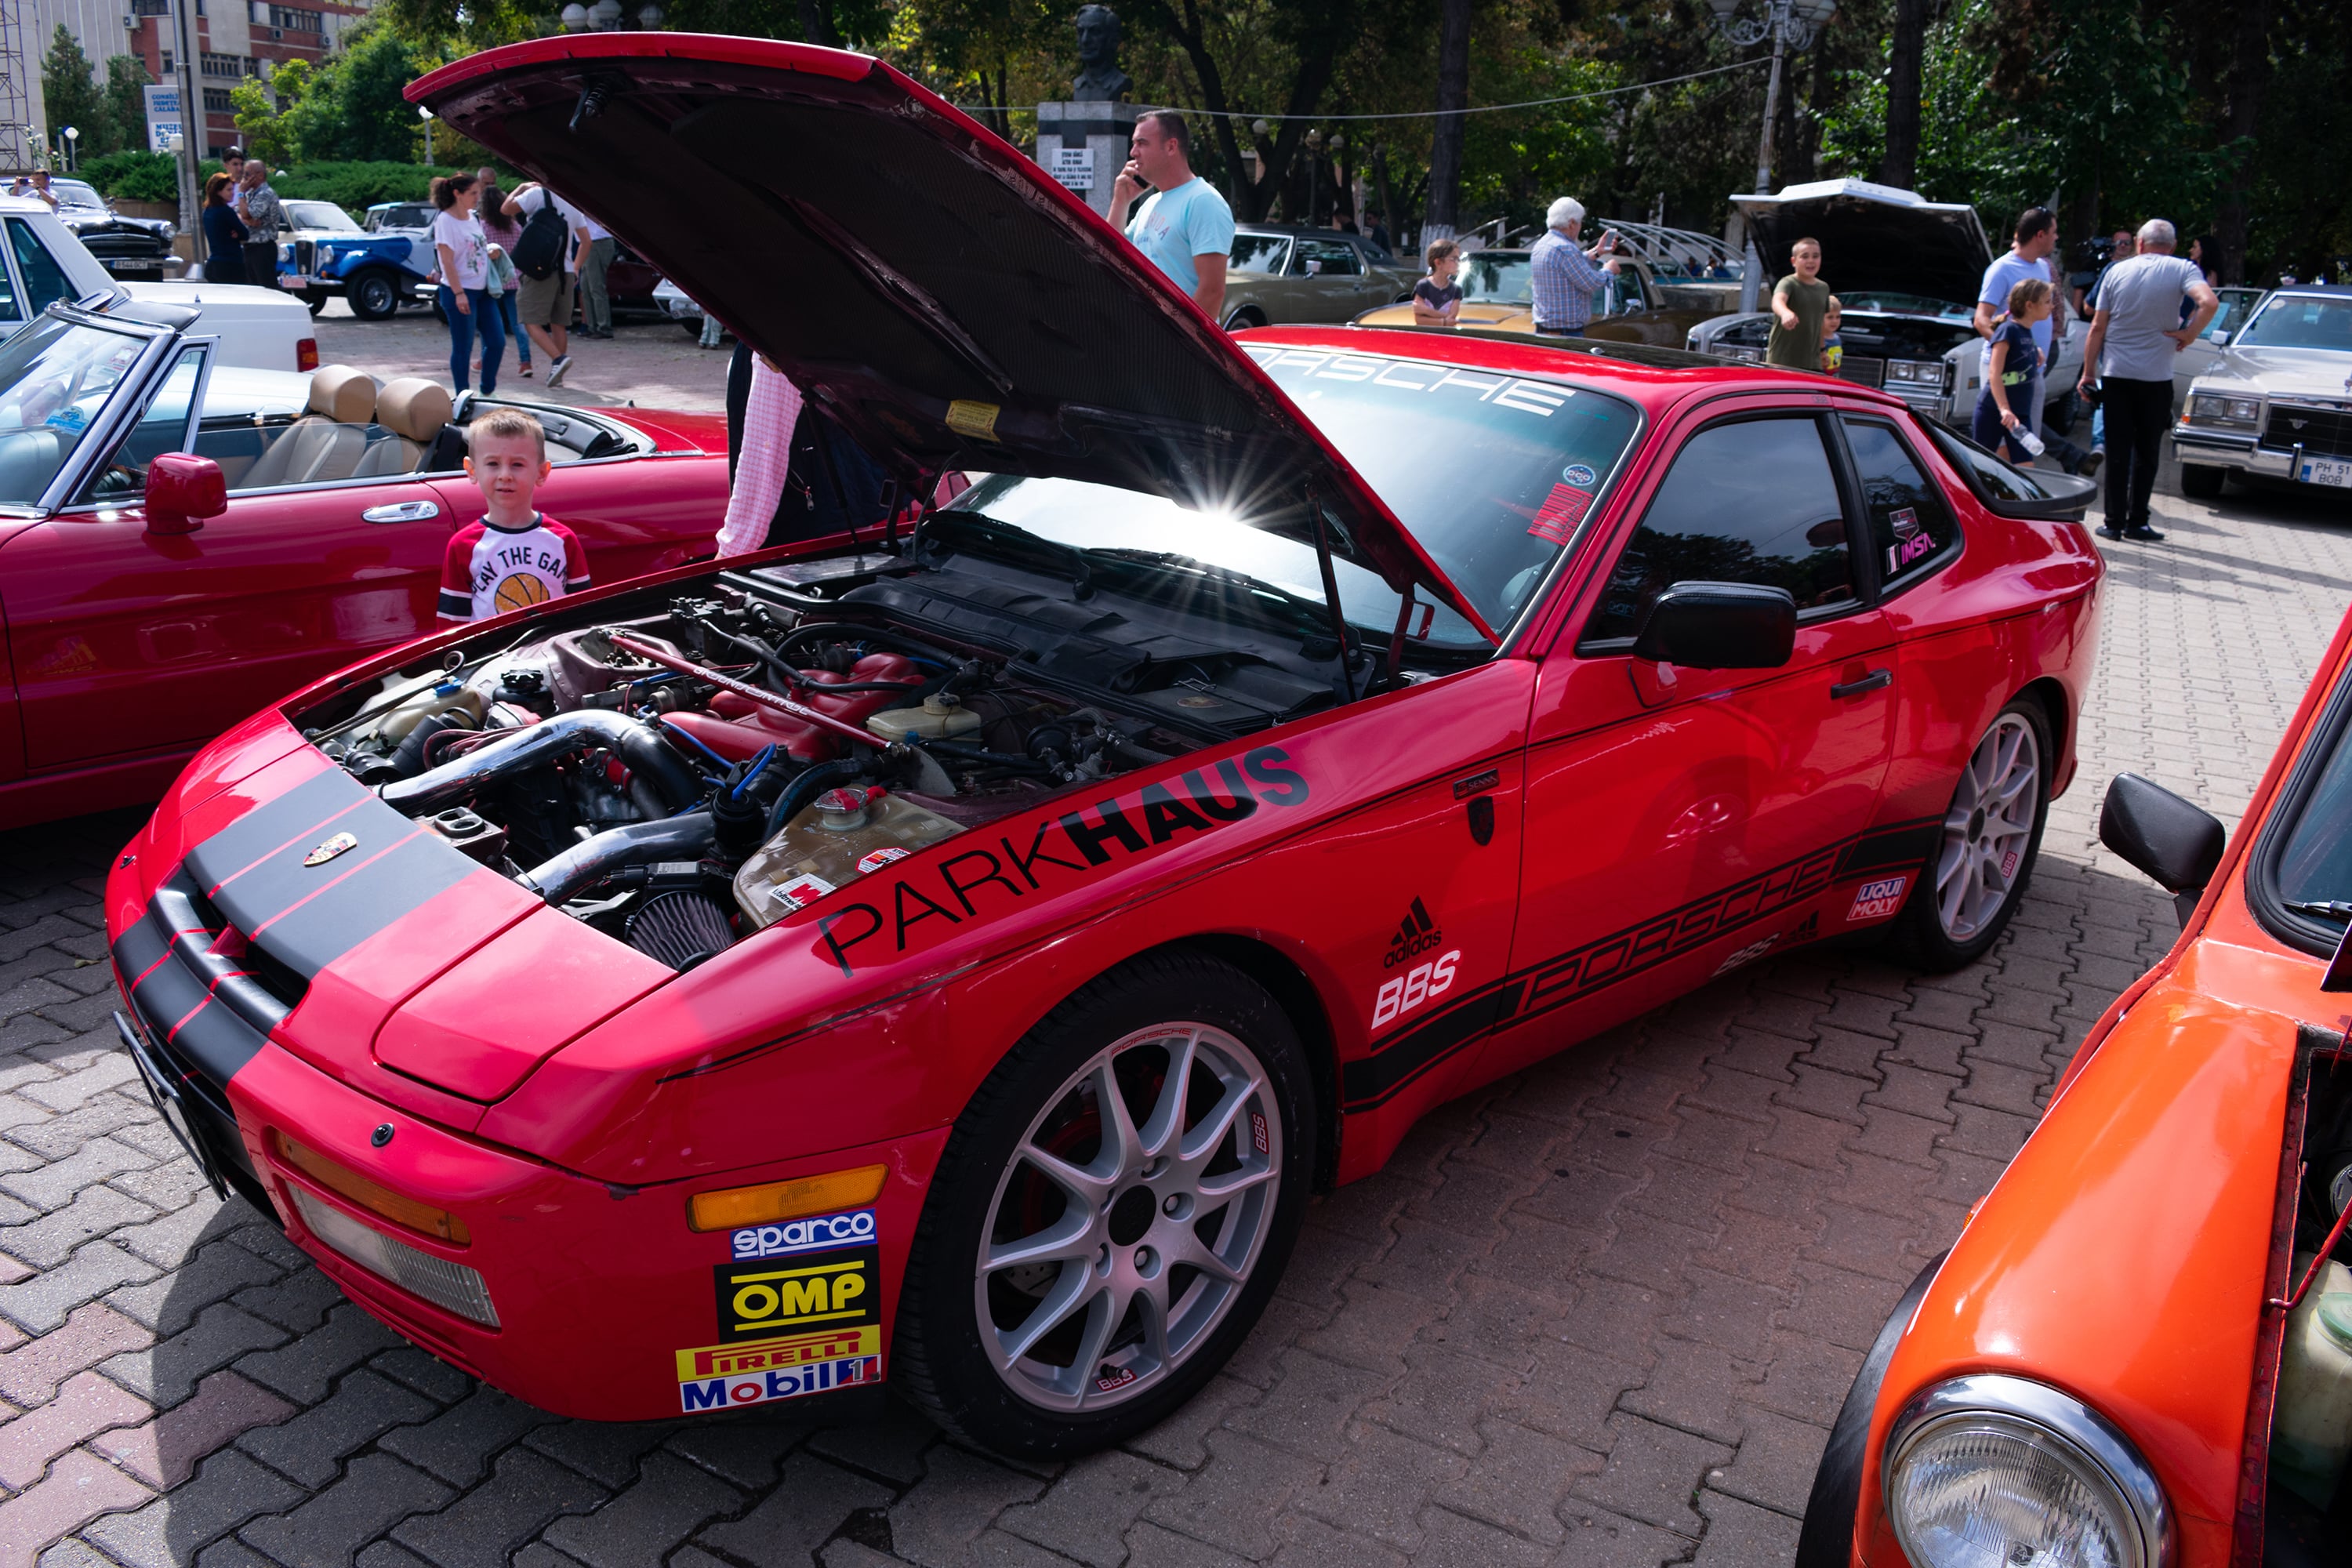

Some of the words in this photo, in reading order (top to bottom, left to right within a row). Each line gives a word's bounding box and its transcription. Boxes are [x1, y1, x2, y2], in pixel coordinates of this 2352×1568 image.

[2315, 462, 2332, 474] PH
[2337, 465, 2350, 475] 51
[2318, 474, 2343, 485] BOB
[497, 546, 532, 568] THE
[693, 666, 746, 691] GROUND
[745, 684, 811, 715] CONTROL
[817, 746, 1309, 978] PARKHAUS
[1851, 898, 1897, 918] MOLY
[1858, 879, 1904, 902] LIQUI
[1384, 930, 1442, 968] adidas
[1525, 852, 1834, 1011] PORSCHE
[1371, 949, 1461, 1029] BBS
[1111, 1028, 1192, 1057] PORSCHE
[1252, 1113, 1267, 1152] BBS
[734, 1212, 874, 1256] sparco
[732, 1272, 866, 1319] OMP
[694, 1331, 862, 1376] PIRELLI
[683, 1363, 830, 1410] Mobil
[849, 1360, 864, 1381] 1
